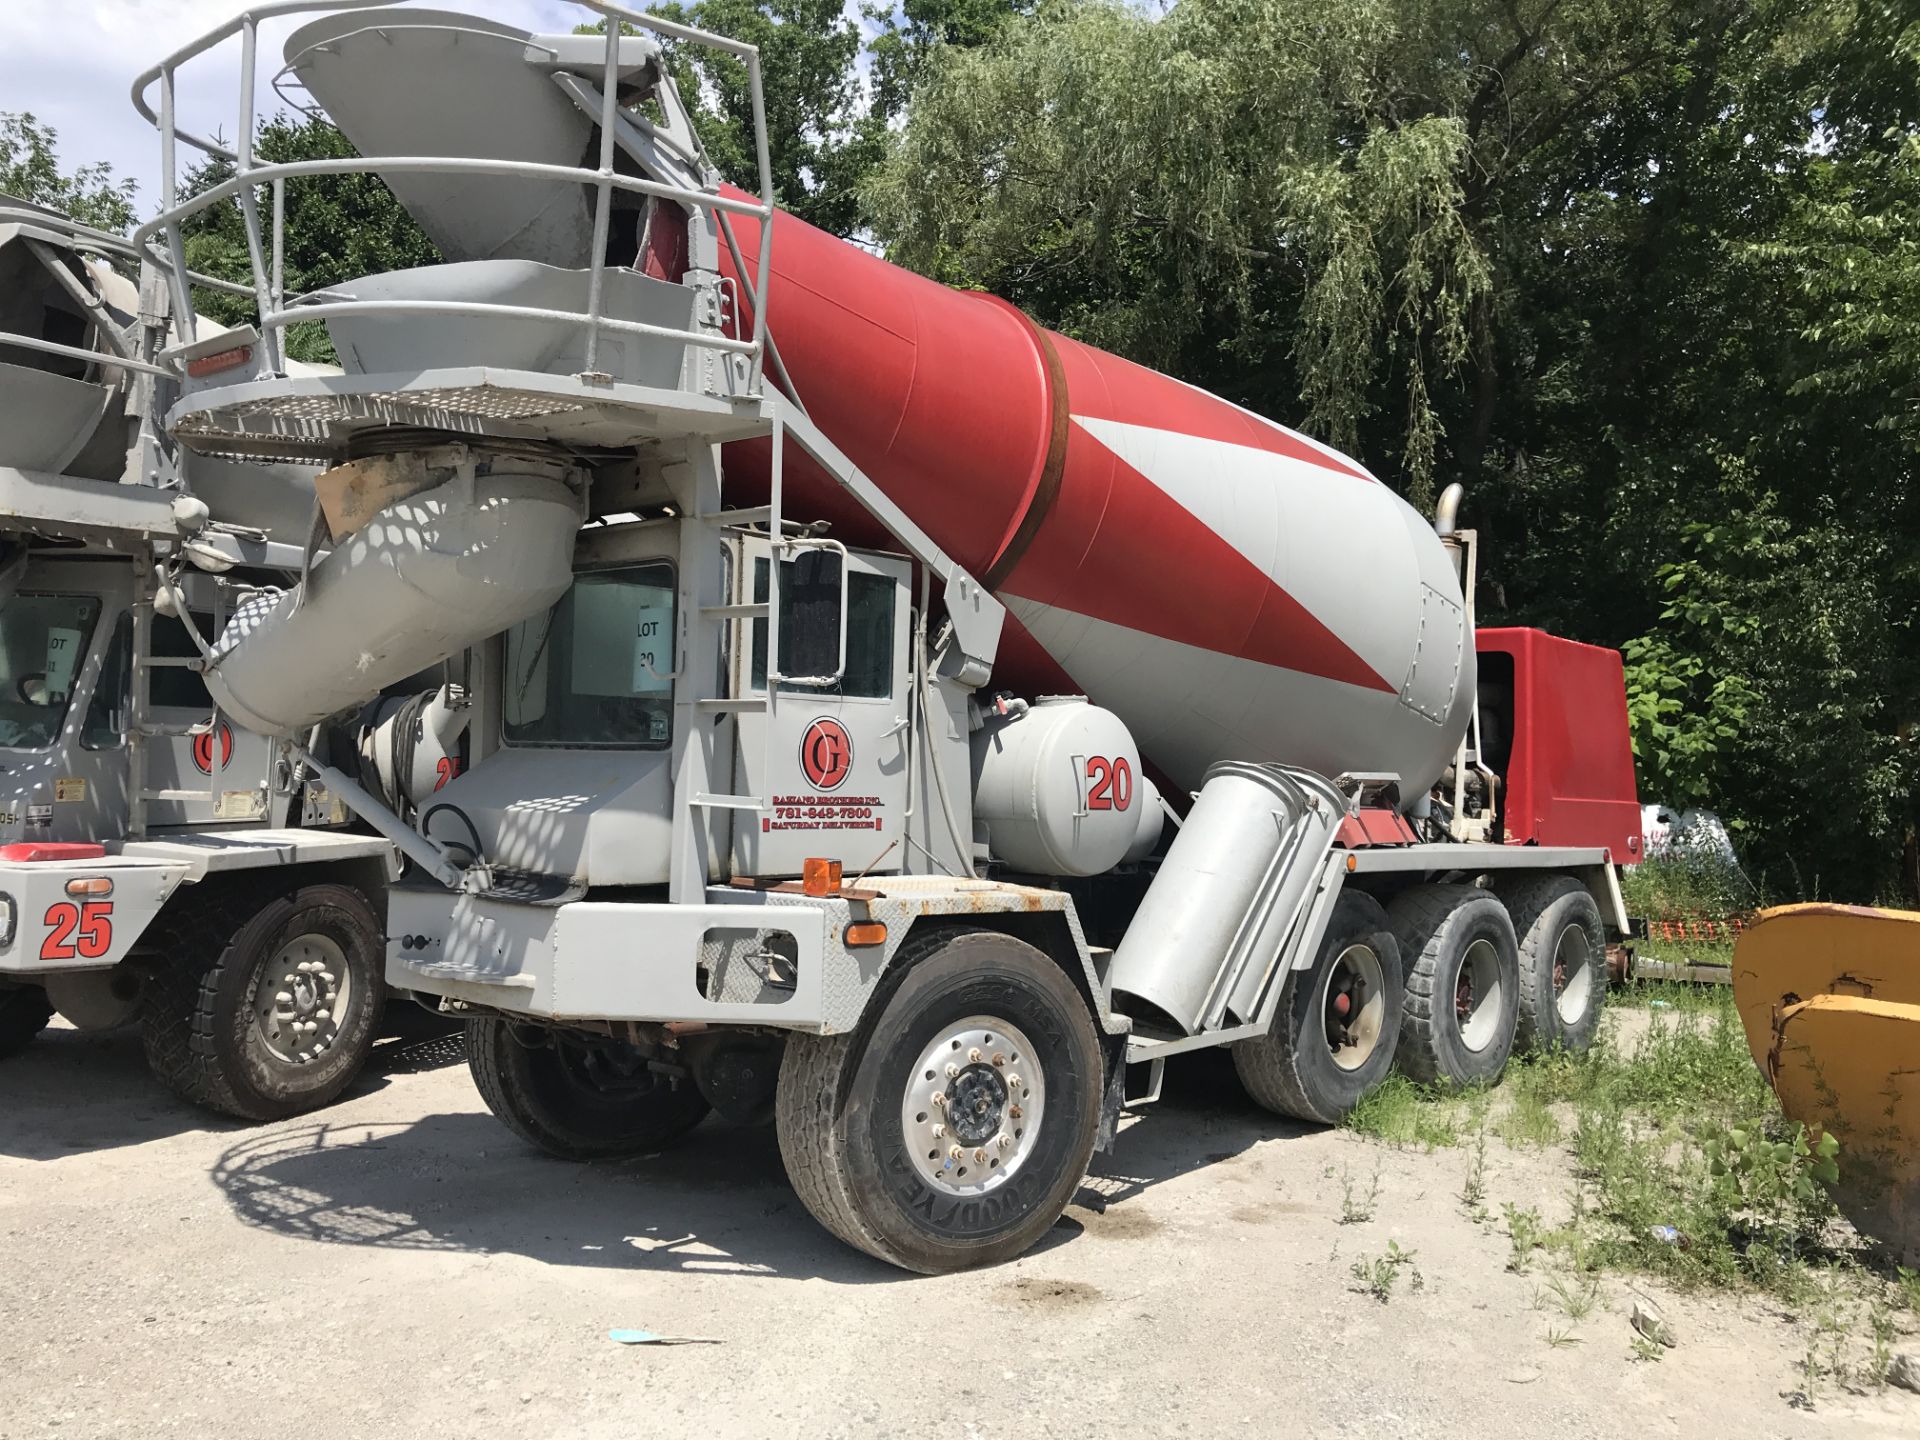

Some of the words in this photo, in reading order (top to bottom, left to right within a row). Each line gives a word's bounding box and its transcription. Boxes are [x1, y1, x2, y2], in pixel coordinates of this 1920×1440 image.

[638, 622, 659, 637] LOT
[49, 638, 67, 650] OT
[813, 734, 841, 774] G
[1087, 756, 1132, 812] 20
[771, 822, 820, 830] SATURDAY
[39, 902, 114, 961] 25
